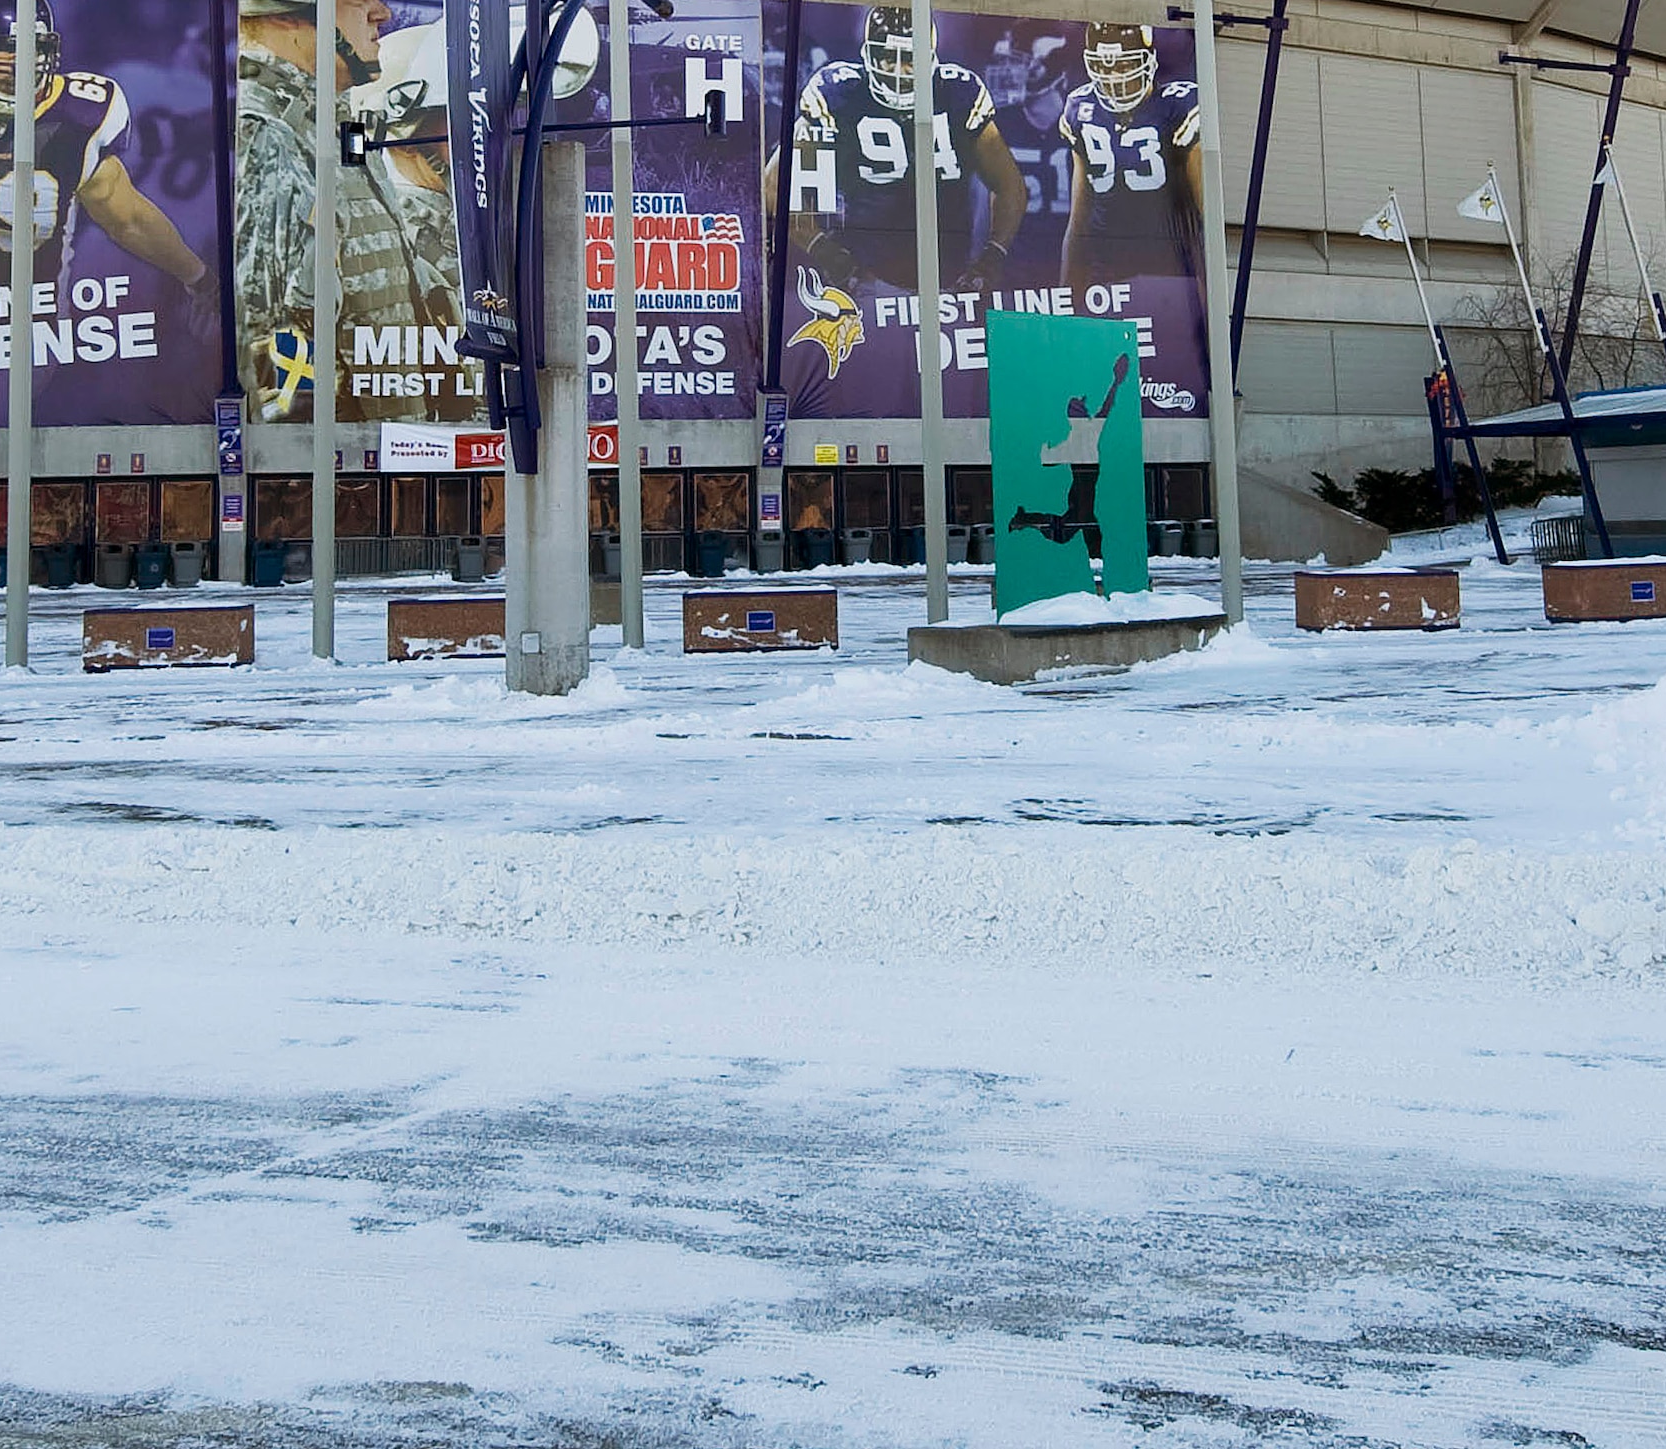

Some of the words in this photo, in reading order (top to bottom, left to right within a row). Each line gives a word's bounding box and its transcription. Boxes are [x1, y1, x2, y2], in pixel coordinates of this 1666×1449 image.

[685, 34, 742, 52] GATE
[685, 57, 743, 122] H
[796, 126, 835, 142] ATE
[1081, 123, 1166, 193] 93
[789, 148, 836, 212] H
[585, 216, 703, 241] NAIONAL
[71, 275, 130, 311] OF
[588, 294, 739, 310] NATALGUARD.COM
[1084, 284, 1131, 315] OF
[352, 373, 445, 398] FIRST
[591, 371, 735, 396] DFENSE
[1139, 377, 1177, 400] kings
